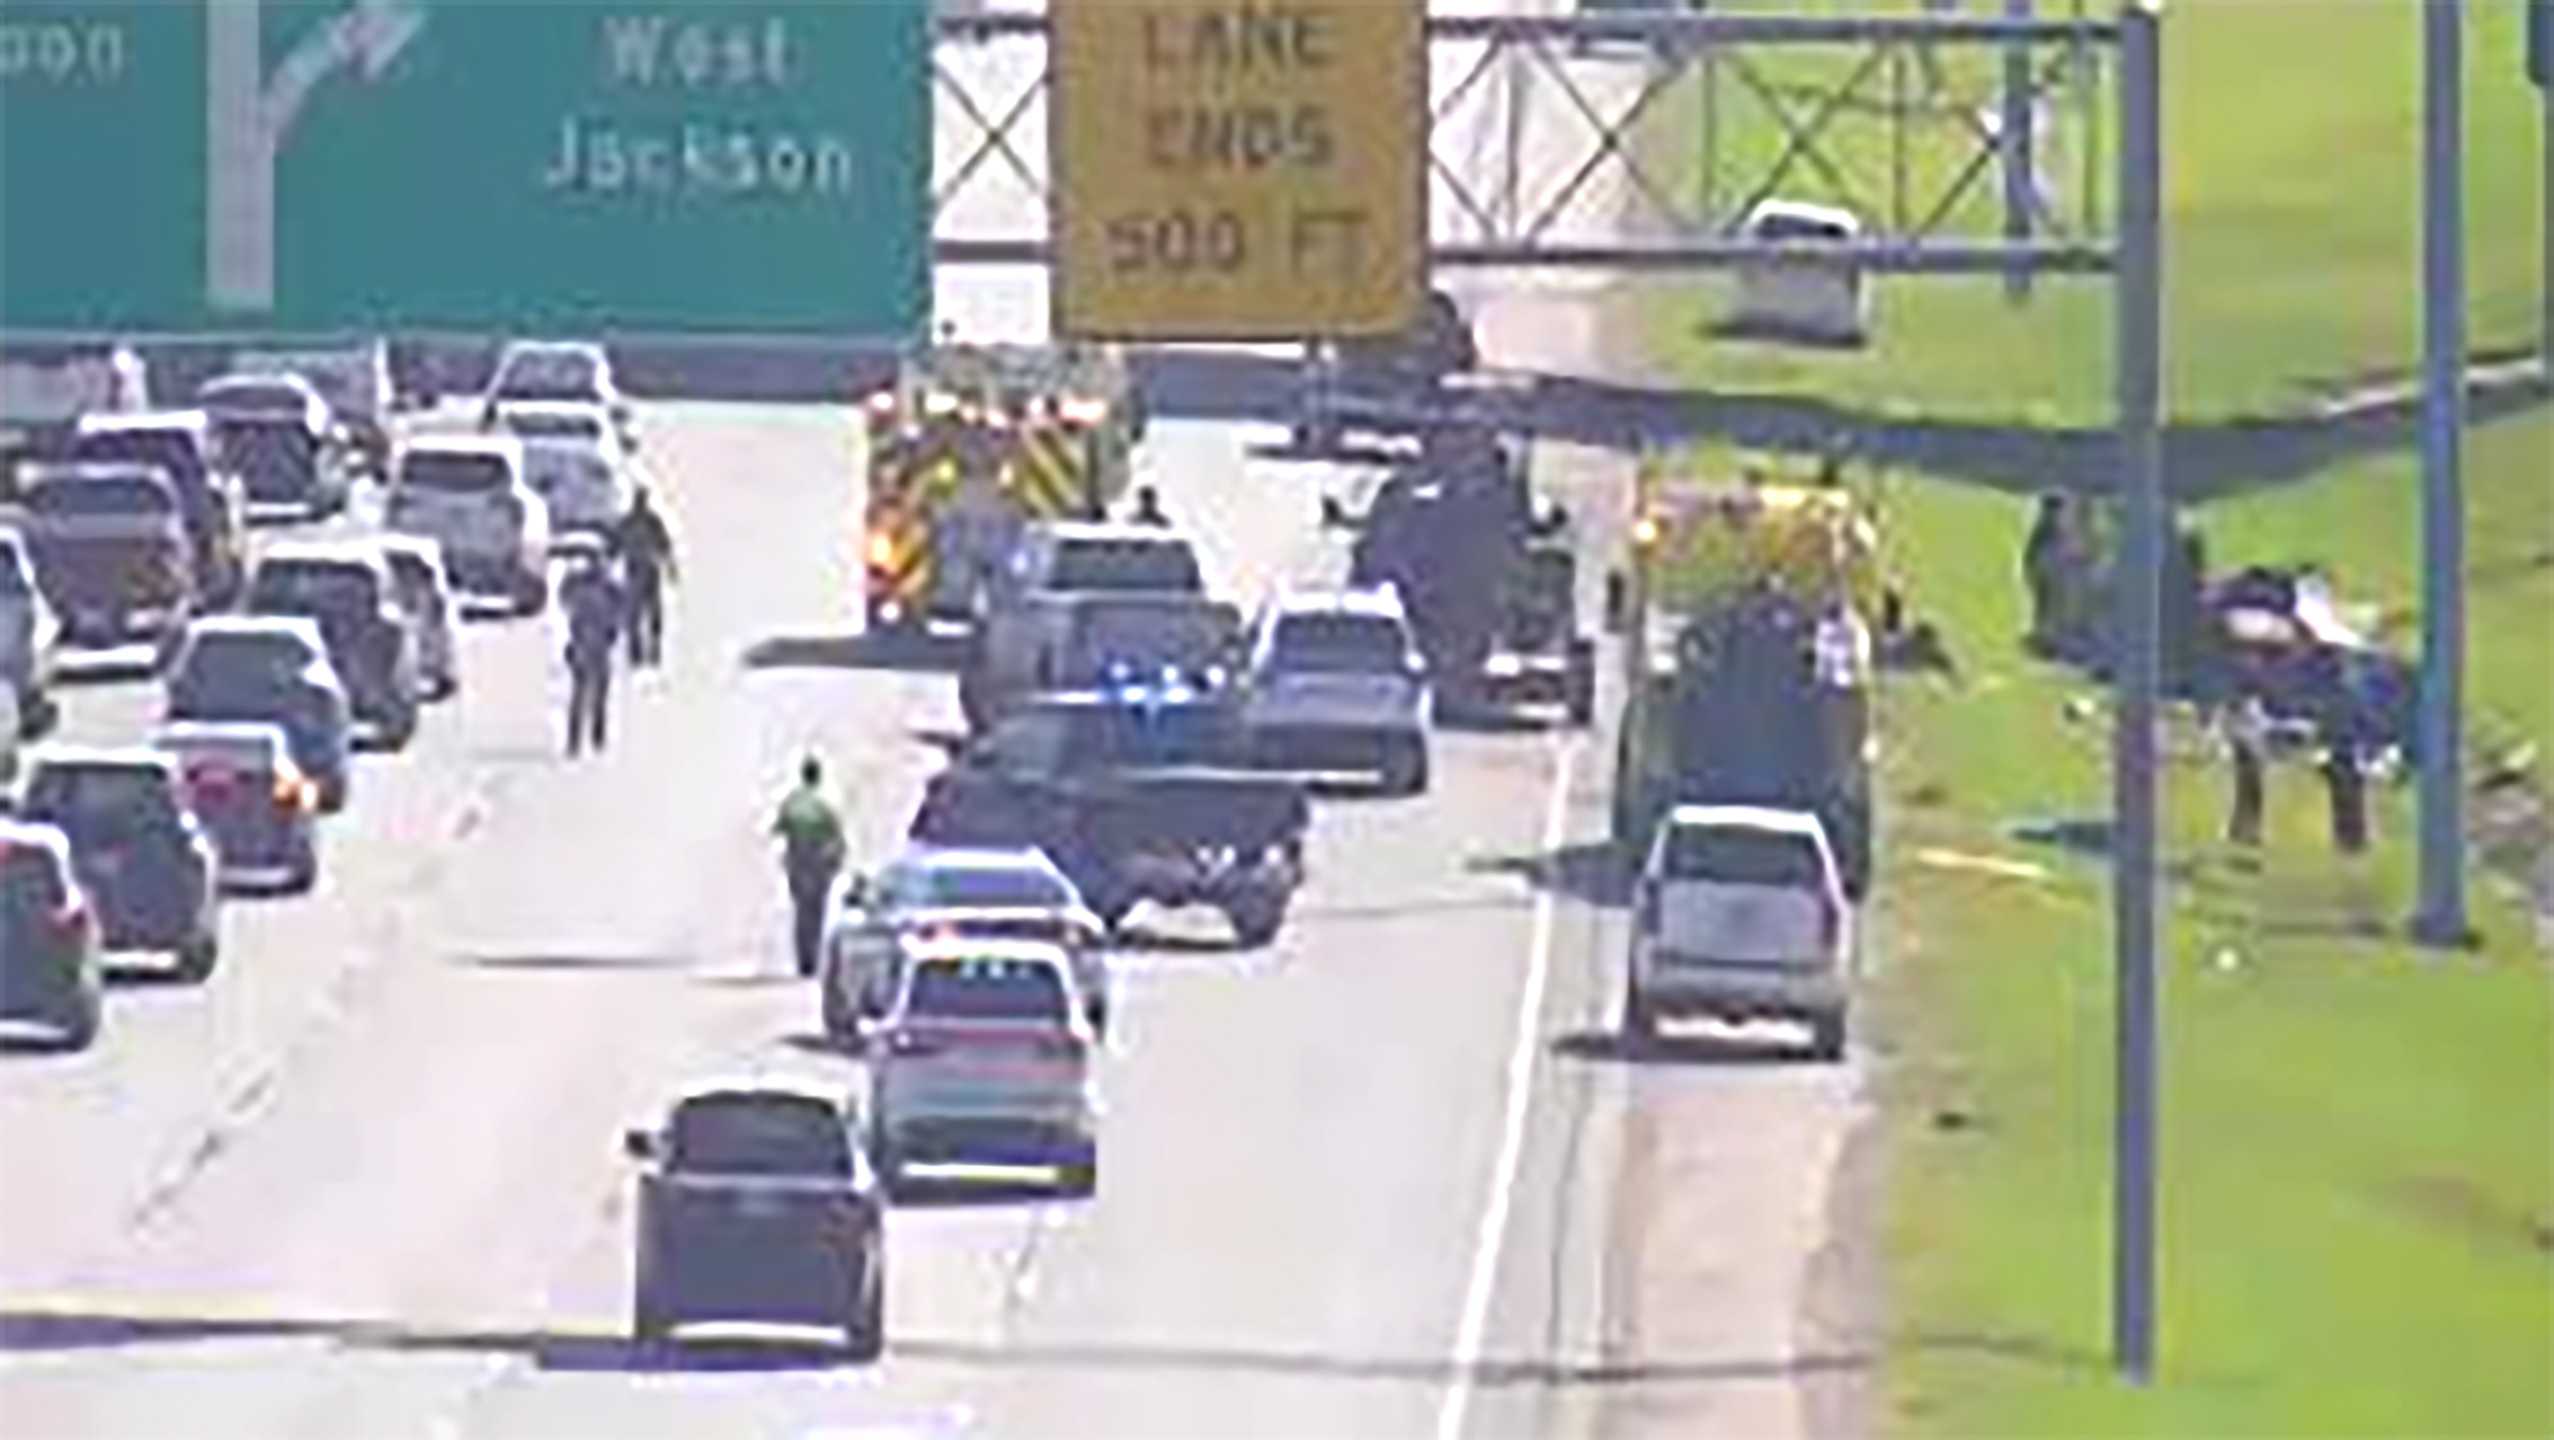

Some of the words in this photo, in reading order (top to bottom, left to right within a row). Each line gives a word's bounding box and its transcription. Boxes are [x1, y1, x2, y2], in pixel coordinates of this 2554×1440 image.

[602, 16, 800, 84] West
[1143, 12, 1338, 68] LANE
[546, 114, 851, 190] Jackson
[1148, 104, 1335, 168] ENDS
[1106, 210, 1247, 270] 500
[1289, 208, 1369, 278] FT
